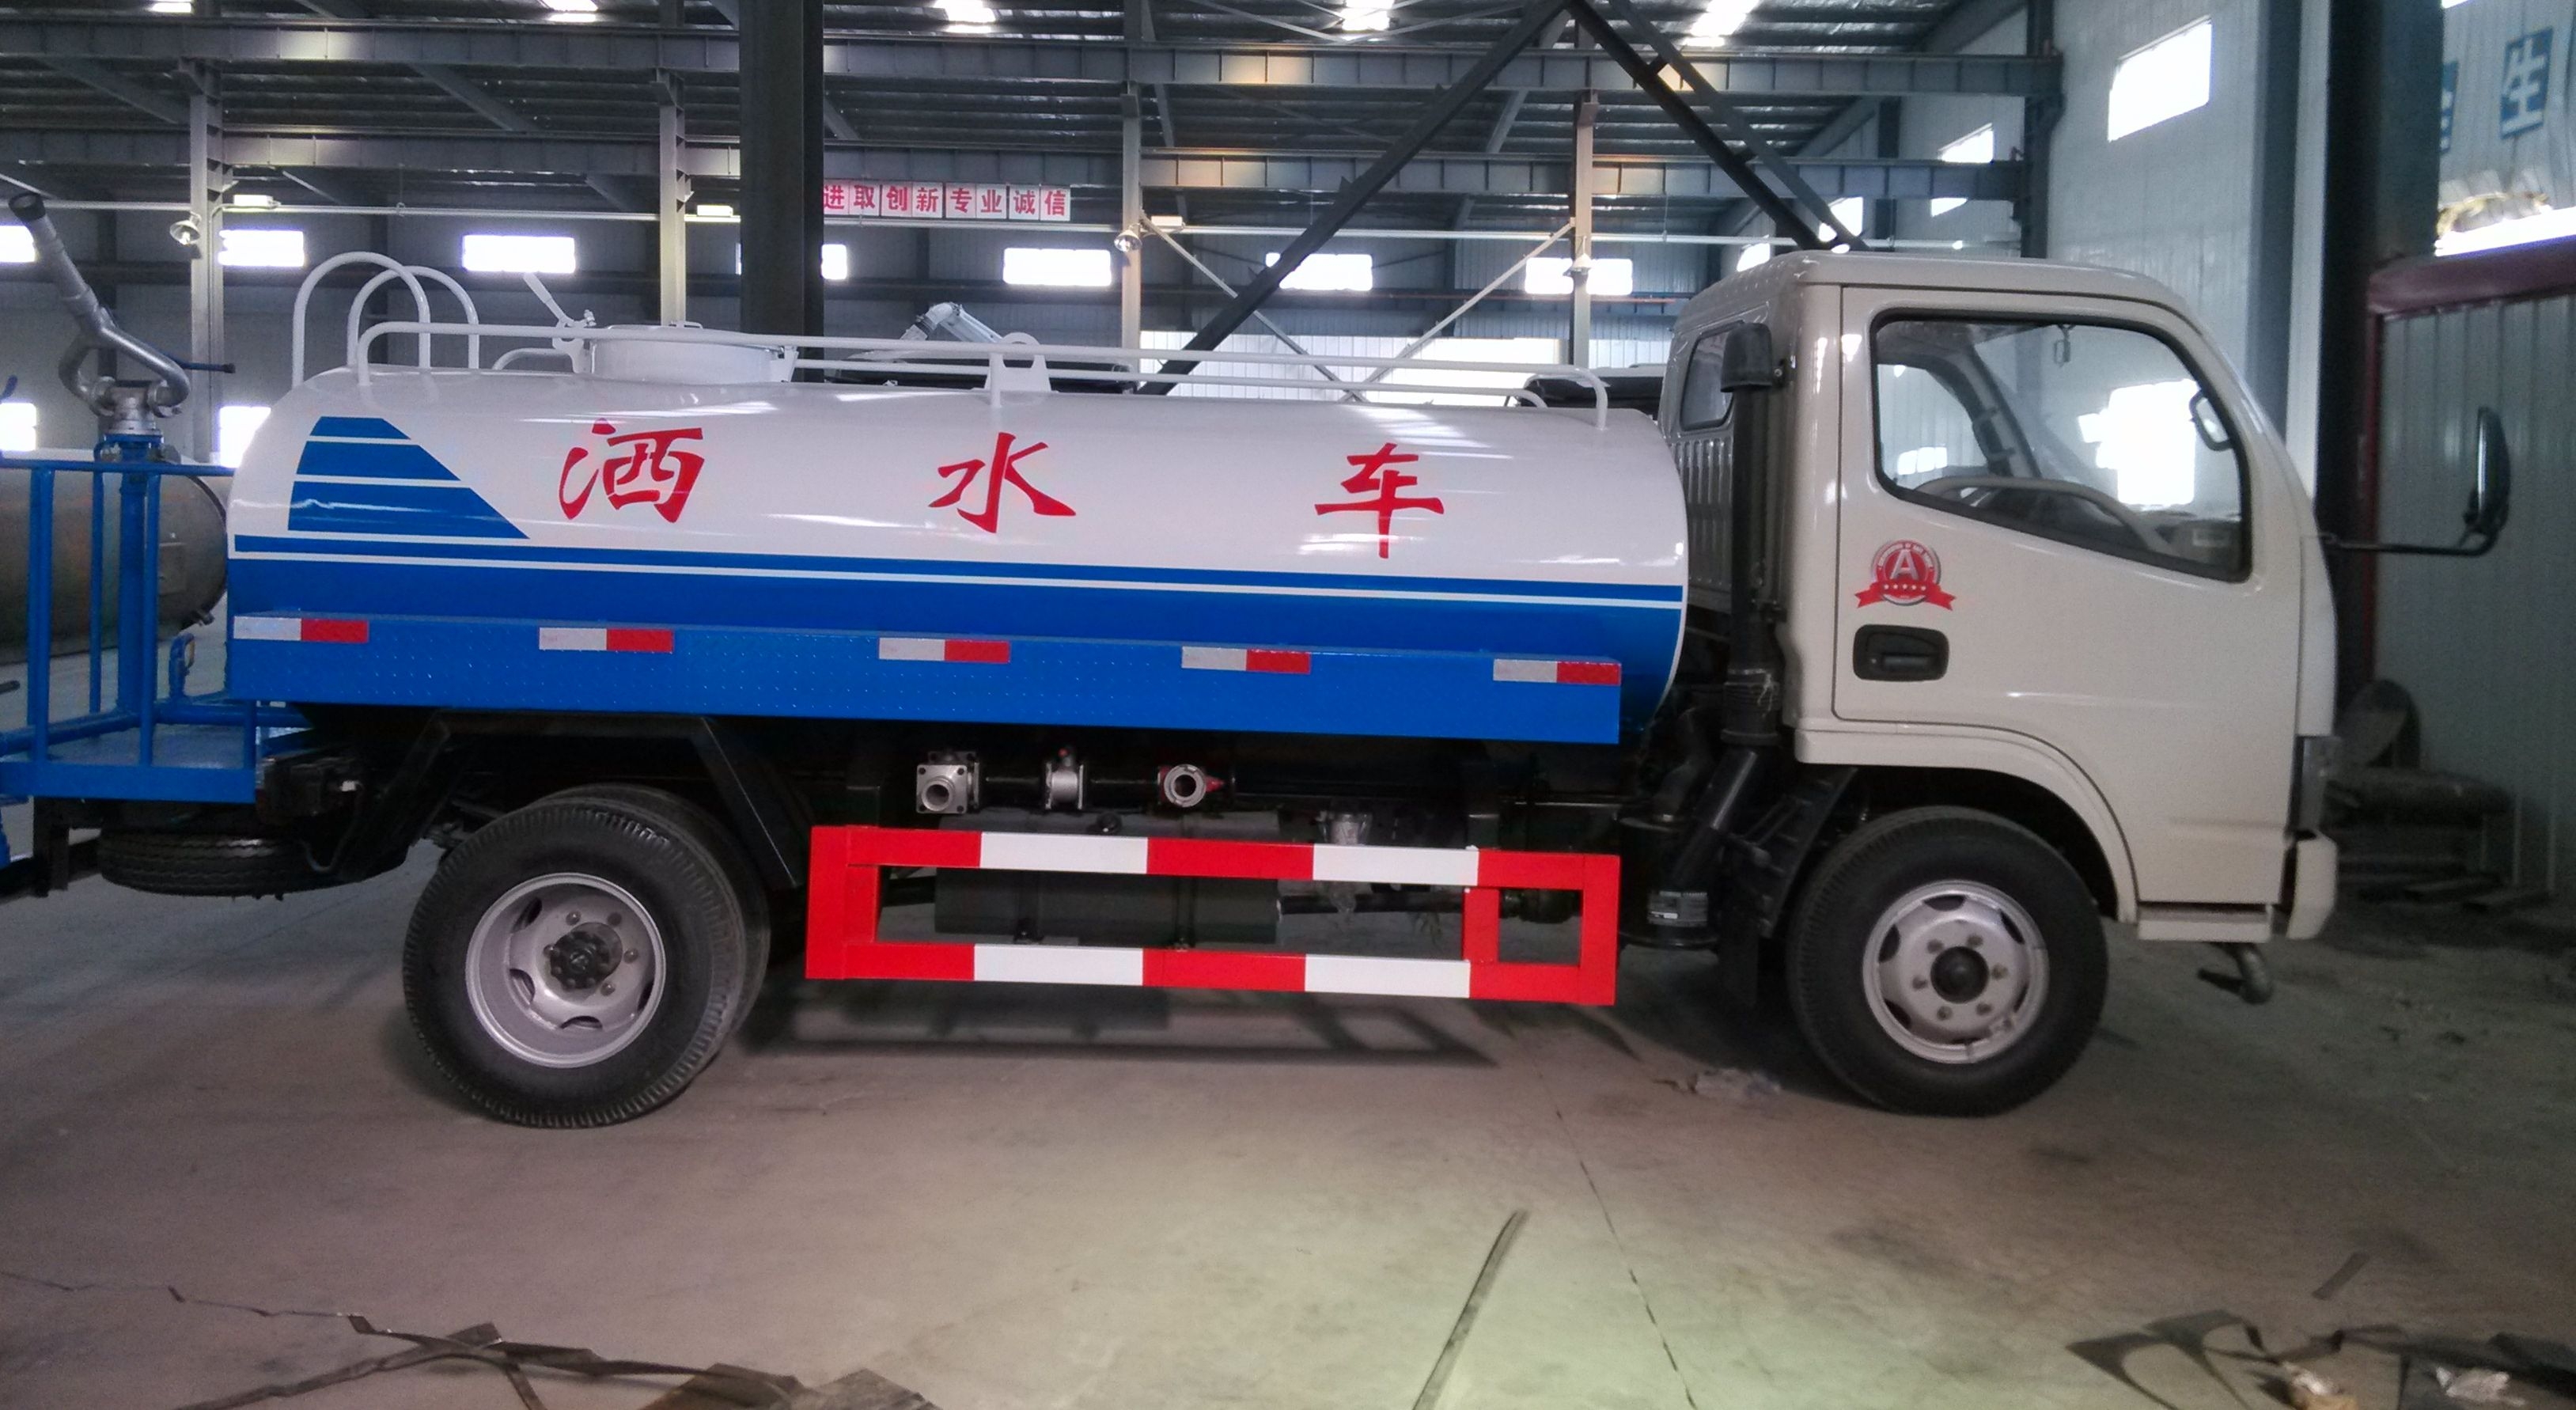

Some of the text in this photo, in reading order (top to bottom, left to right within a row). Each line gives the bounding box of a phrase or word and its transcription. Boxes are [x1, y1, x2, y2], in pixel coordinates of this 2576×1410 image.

[823, 184, 1066, 217] 进取创新专业诚信
